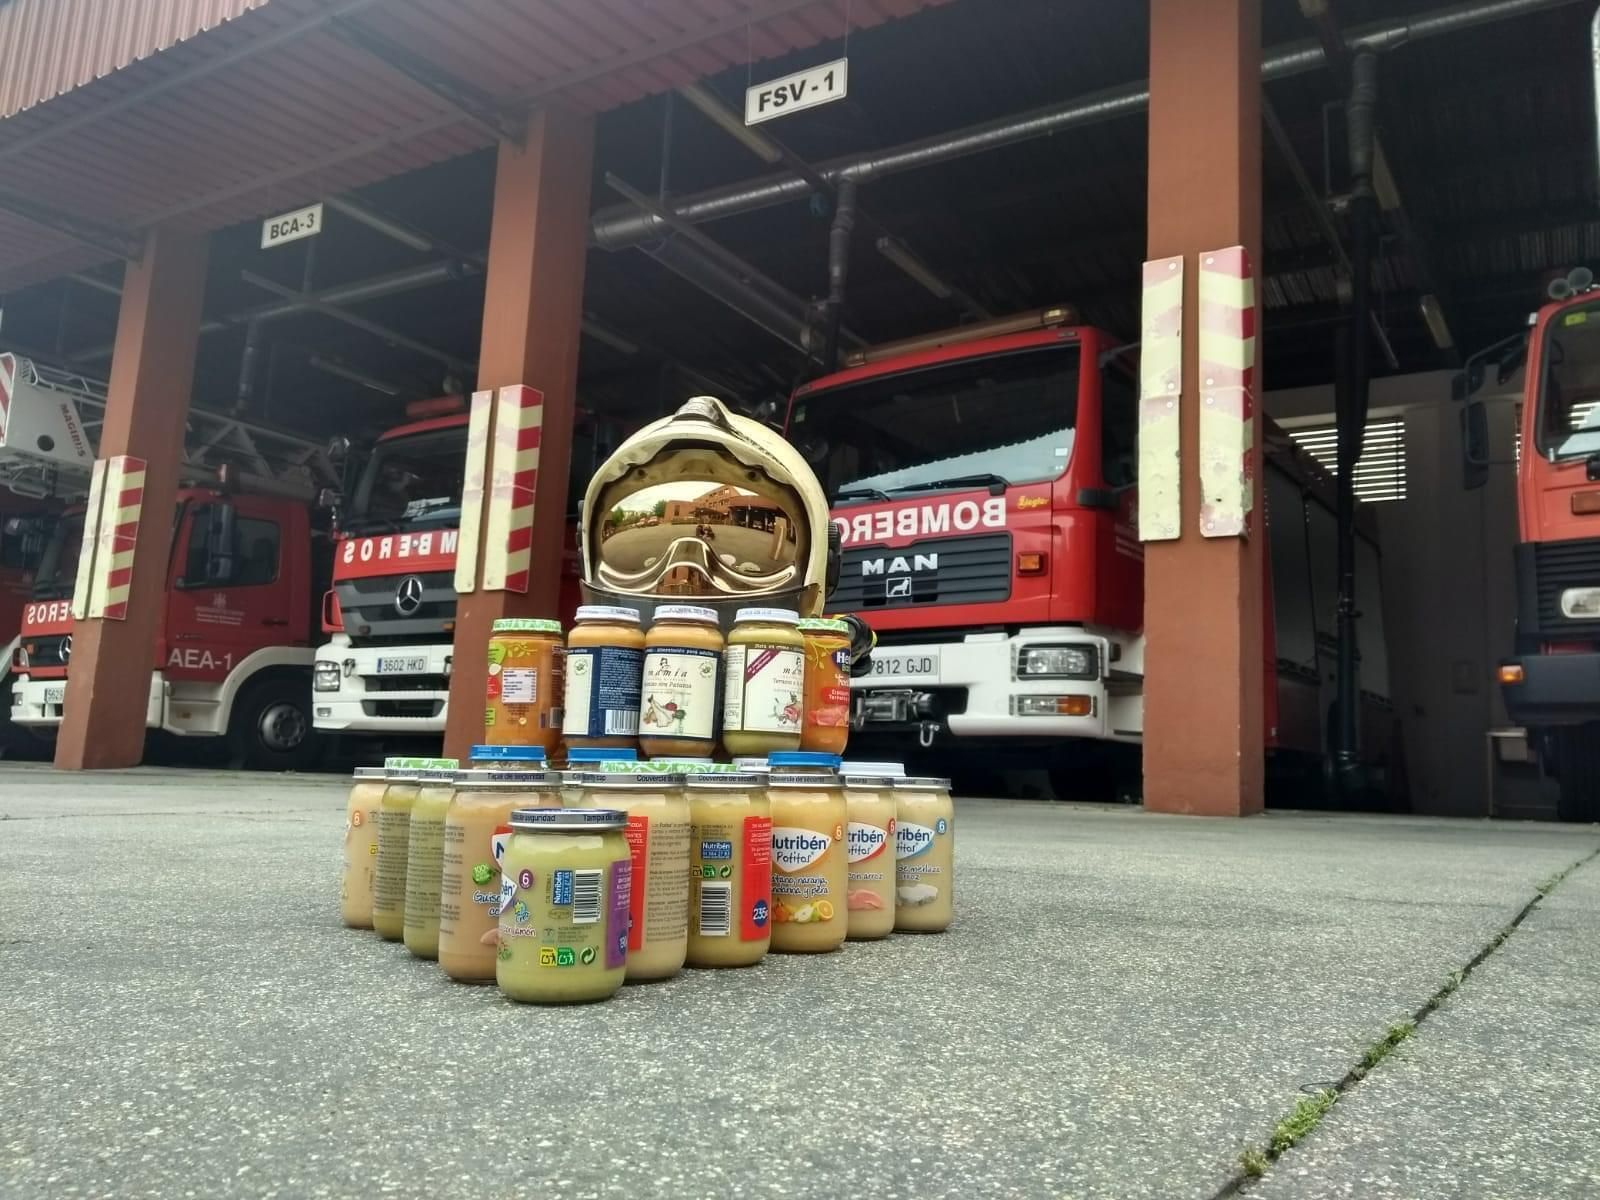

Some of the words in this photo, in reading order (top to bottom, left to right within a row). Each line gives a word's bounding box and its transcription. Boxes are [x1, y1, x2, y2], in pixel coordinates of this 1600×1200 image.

[758, 79, 807, 113] FSV
[823, 69, 835, 92] 1
[861, 552, 939, 577] MAN
[167, 647, 233, 671] AEA-1
[906, 657, 932, 673] GJD
[938, 820, 945, 830] 6
[897, 827, 930, 842] ribén
[522, 872, 530, 884] 6
